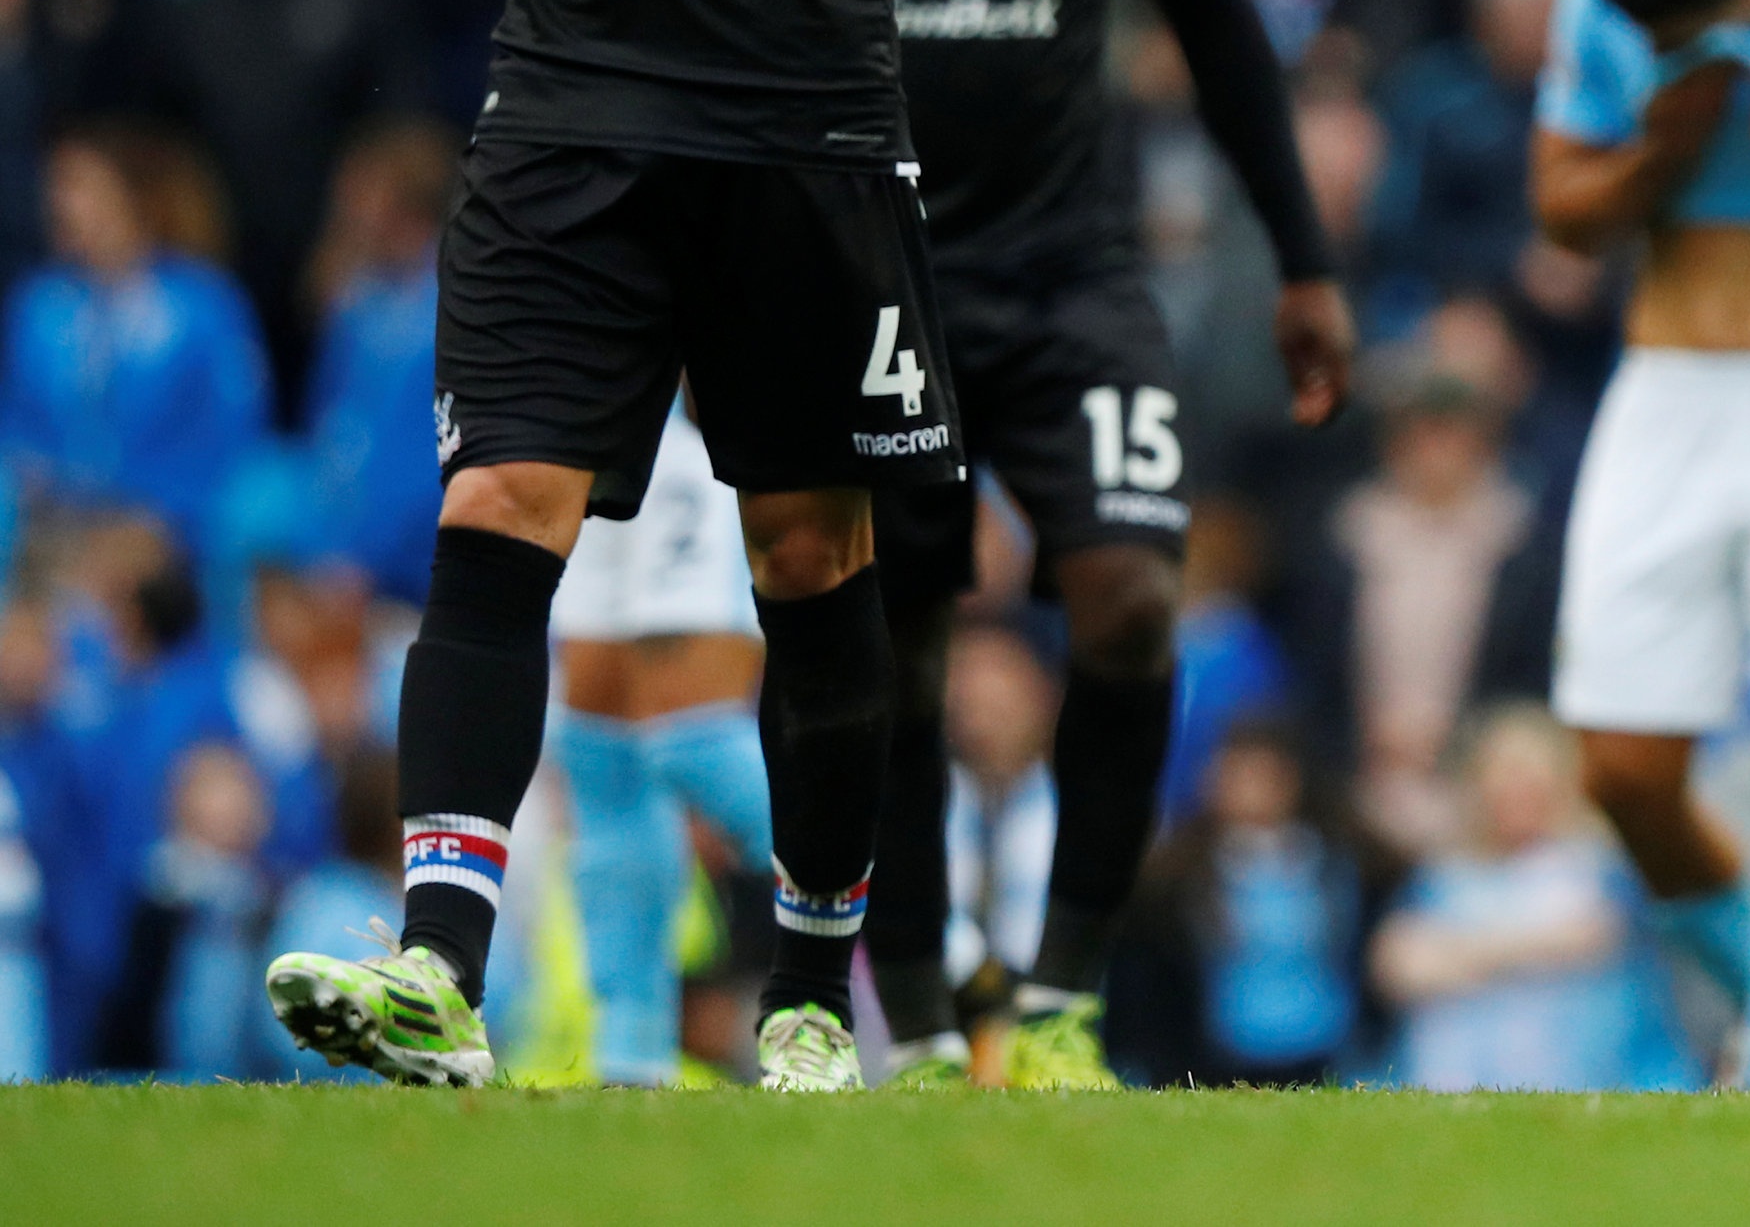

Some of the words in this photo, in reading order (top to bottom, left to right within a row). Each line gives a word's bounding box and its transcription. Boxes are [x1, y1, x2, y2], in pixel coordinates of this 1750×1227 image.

[861, 305, 926, 418] 4
[852, 424, 950, 456] macron
[1080, 385, 1183, 492] 15
[404, 836, 462, 870] PFC
